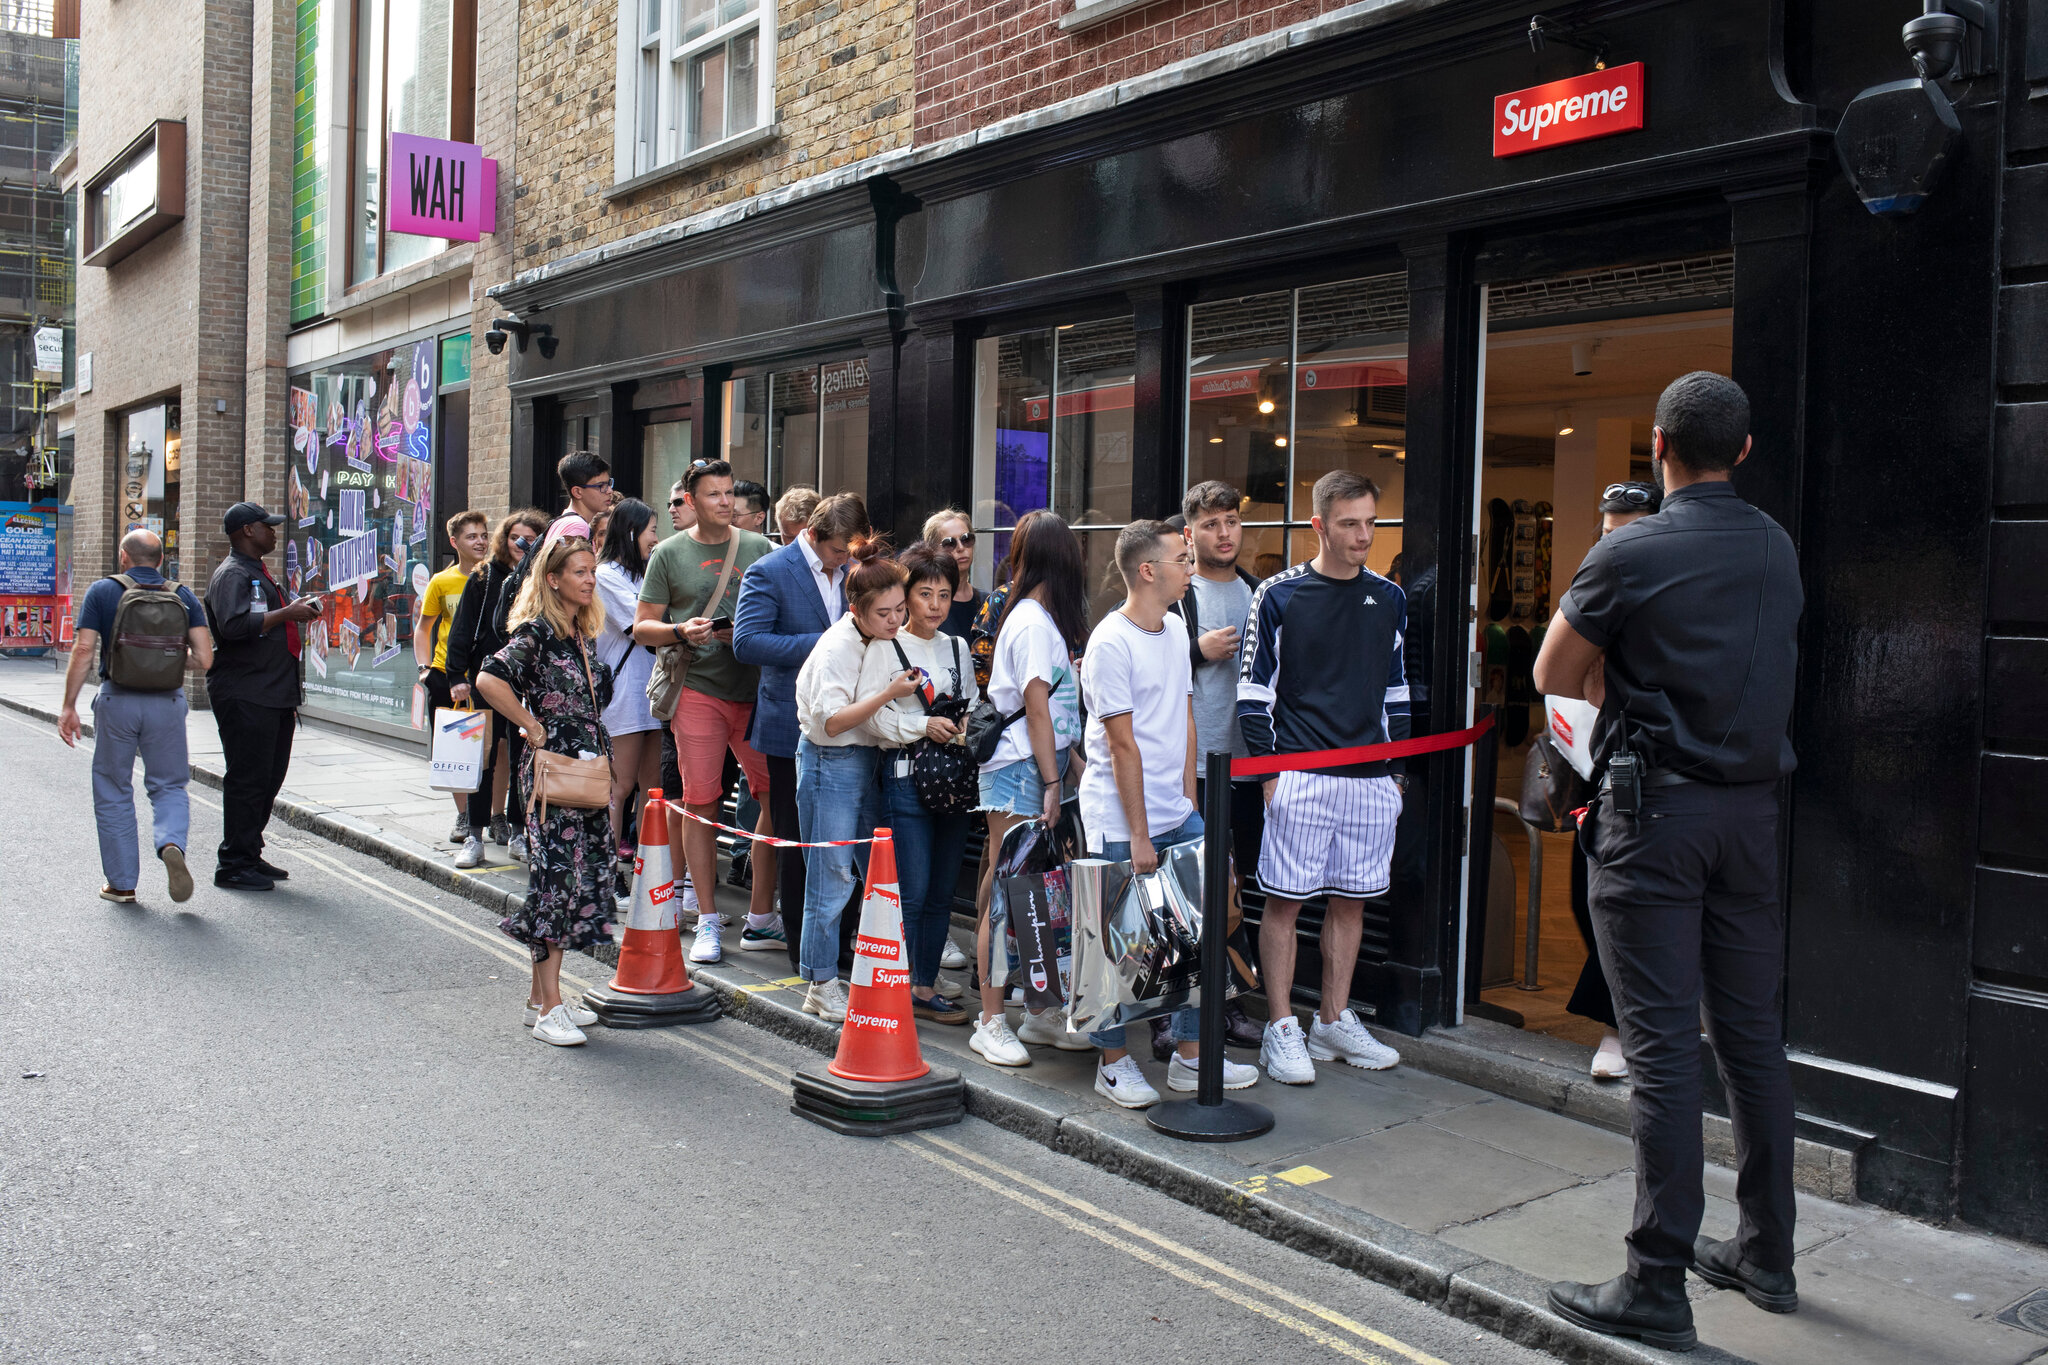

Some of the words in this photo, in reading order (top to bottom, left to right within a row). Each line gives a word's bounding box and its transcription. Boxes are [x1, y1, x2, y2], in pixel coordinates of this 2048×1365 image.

[1501, 85, 1628, 141] Supreme
[409, 152, 465, 223] WAH
[337, 470, 374, 487] PAY
[6, 526, 44, 534] GOLDIE
[302, 681, 323, 692] DOWNLOAD
[323, 685, 349, 697] BEAUTYSTACK
[349, 690, 361, 699] FROM
[361, 693, 370, 701] THE
[370, 694, 379, 702] APP
[379, 696, 394, 706] STORE
[433, 763, 471, 772] OFFICE
[653, 886, 674, 900] Supr
[856, 937, 898, 956] upreme
[1027, 890, 1048, 993] Champion
[875, 969, 910, 987] Supre
[848, 1008, 899, 1029] Supreme
